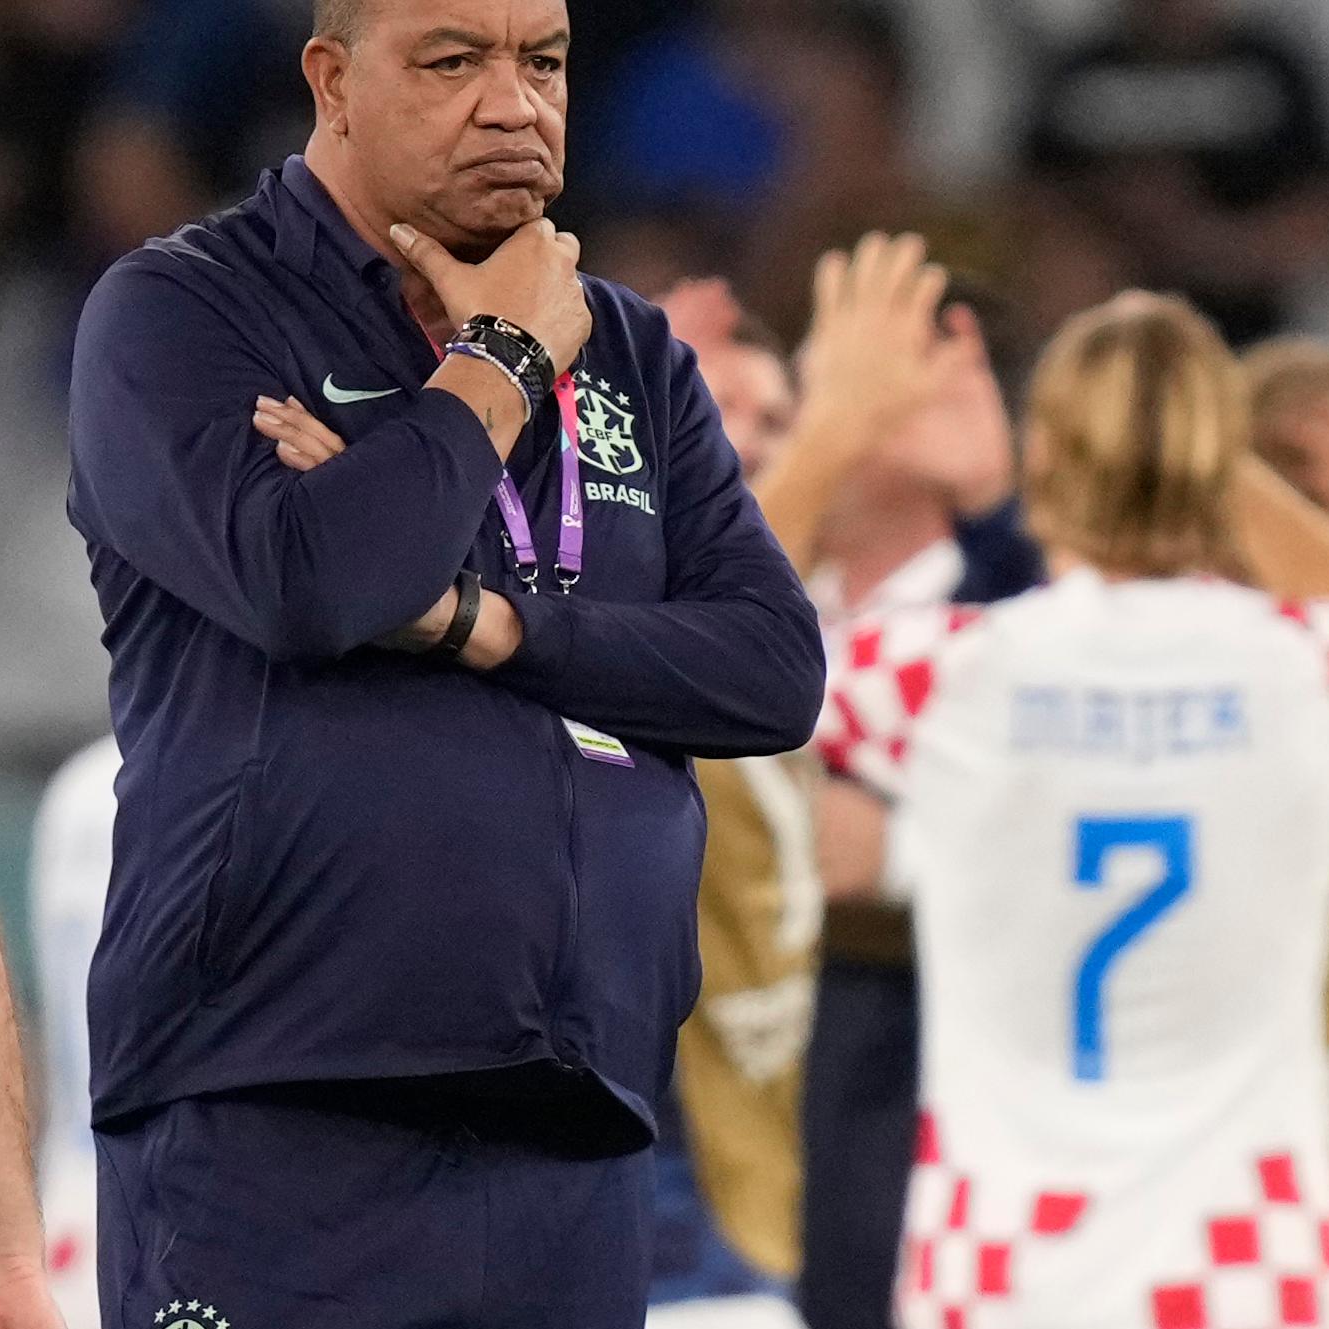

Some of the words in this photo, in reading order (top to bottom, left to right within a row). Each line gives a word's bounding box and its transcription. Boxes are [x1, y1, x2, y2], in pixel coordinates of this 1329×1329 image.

[585, 426, 614, 442] CBF
[584, 481, 657, 516] BRASIL
[1073, 817, 1193, 1081] 7
